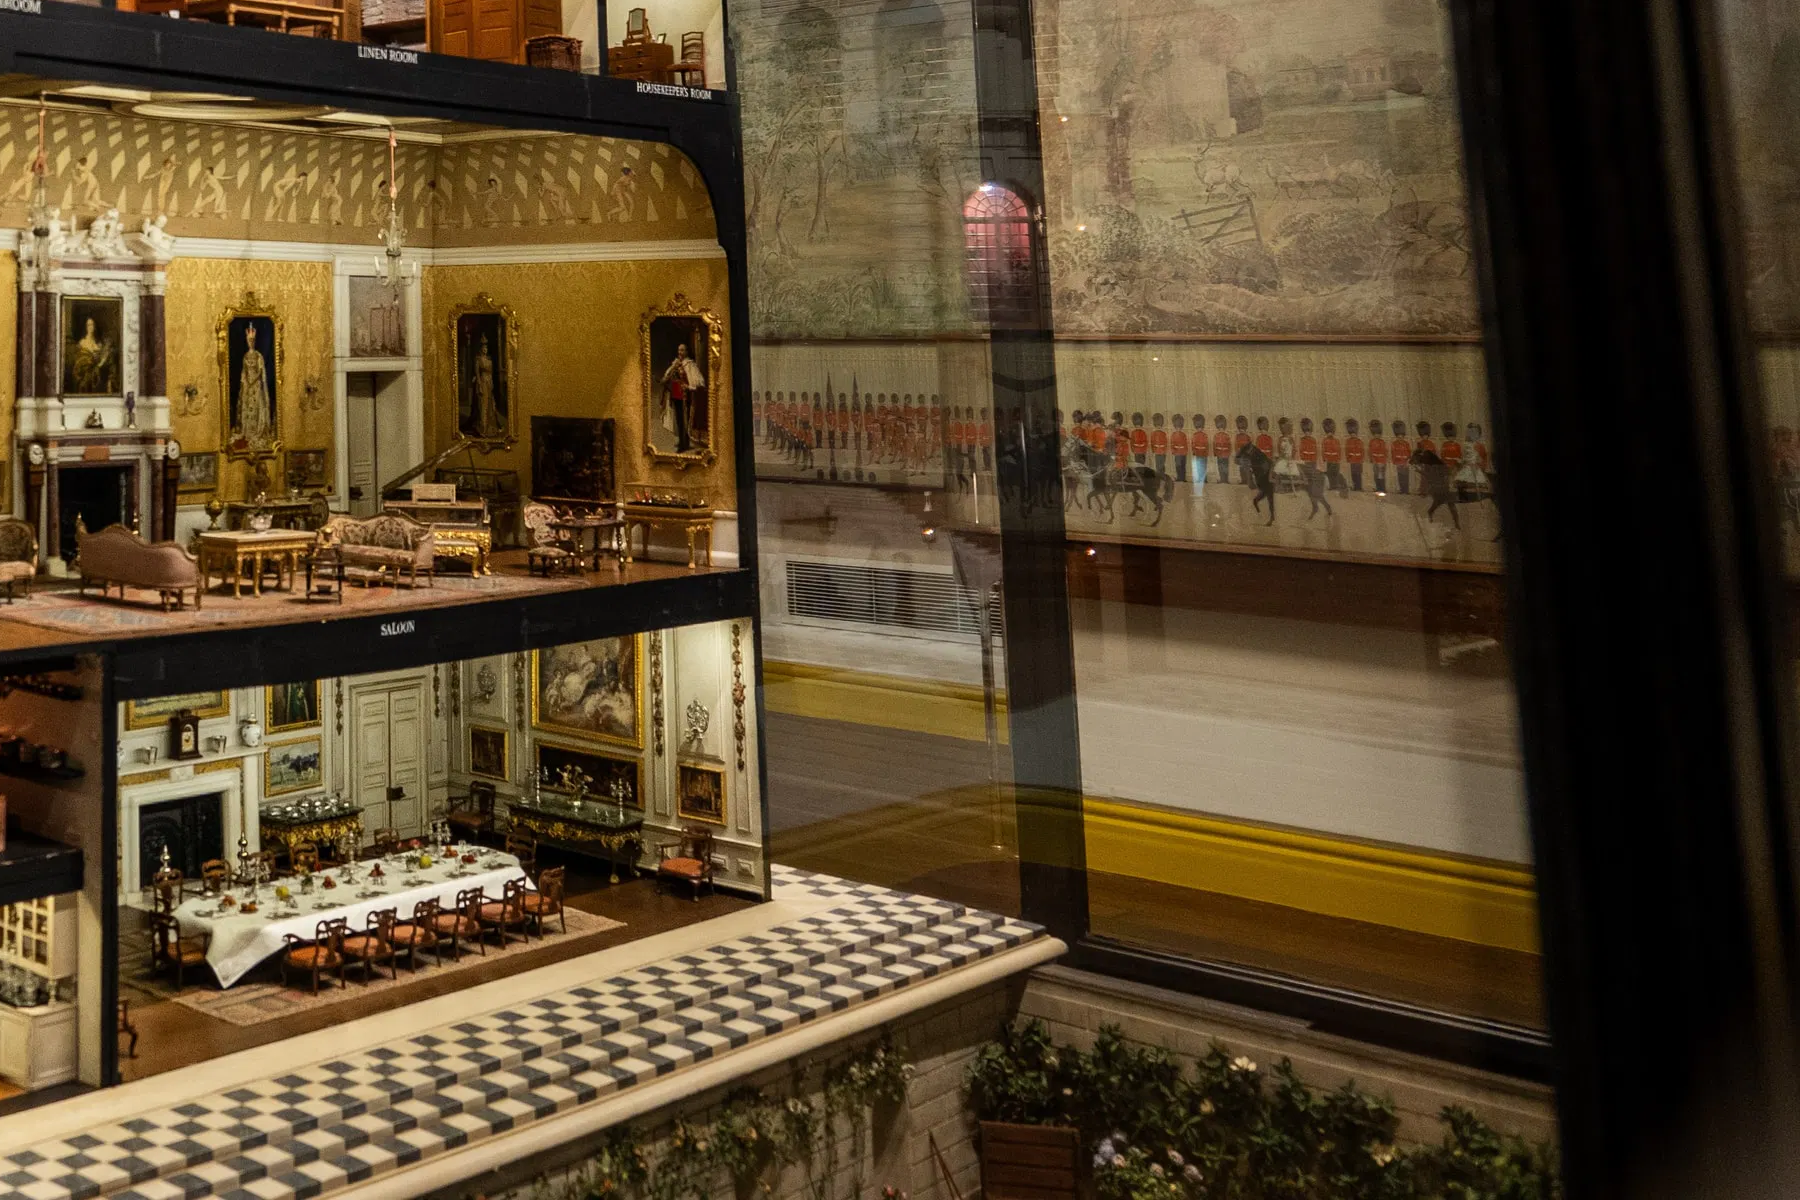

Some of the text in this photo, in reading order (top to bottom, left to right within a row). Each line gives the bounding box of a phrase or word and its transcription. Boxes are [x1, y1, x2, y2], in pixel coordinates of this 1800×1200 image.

[357, 45, 418, 64] LINEN ROOM
[636, 81, 712, 100] HOUSEKEEPER'S ROOM
[380, 620, 415, 636] SALOON
